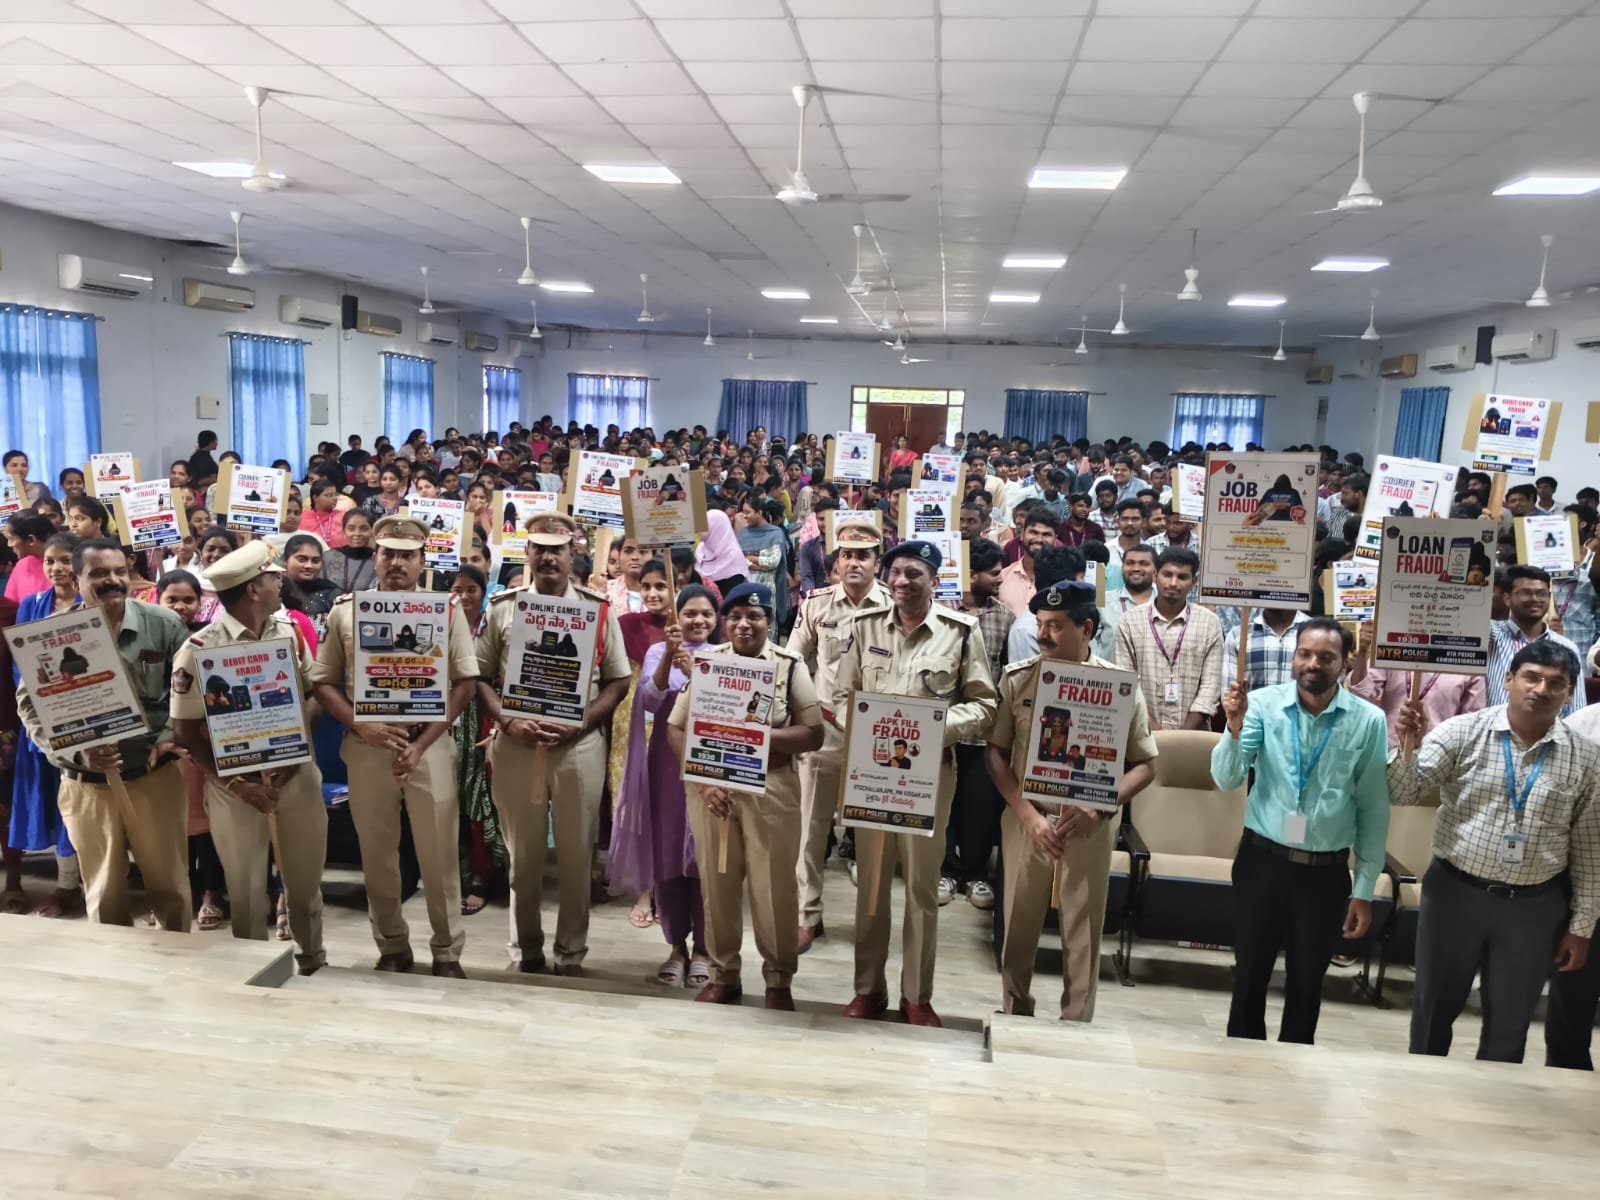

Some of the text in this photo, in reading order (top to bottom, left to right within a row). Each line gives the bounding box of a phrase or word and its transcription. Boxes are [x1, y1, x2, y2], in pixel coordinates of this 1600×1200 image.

[637, 479, 658, 489] JOB
[1383, 476, 1415, 488] COURIER
[1220, 481, 1258, 498] JOB
[1381, 485, 1413, 500] FRAUD
[1218, 498, 1260, 513] FRAUD
[1357, 547, 1375, 556] NTR
[1398, 535, 1444, 555] LOAN
[1396, 554, 1444, 574] FRAUD
[374, 602, 433, 614] OLX మోసం
[530, 603, 581, 616] ONLINE GAMES
[42, 632, 82, 650] FRAUD
[1377, 647, 1401, 658] NTR
[223, 653, 270, 668] DEBIT CARD
[236, 665, 262, 677] FRAUD
[712, 665, 762, 680] INVESTMENT
[718, 676, 752, 692] FRAUD
[1059, 676, 1112, 690] DIGITAL ARREST
[1058, 684, 1112, 706] FRAUD
[356, 703, 376, 712] NTR
[880, 717, 919, 728] APK FILE
[872, 724, 920, 740] FRAUD
[51, 735, 72, 748] NTR
[240, 753, 262, 761] POLICE
[698, 752, 715, 761] 1930
[704, 766, 724, 774] POLICE
[1024, 781, 1069, 792] NTR POLICE
[866, 810, 888, 818] POLICE
